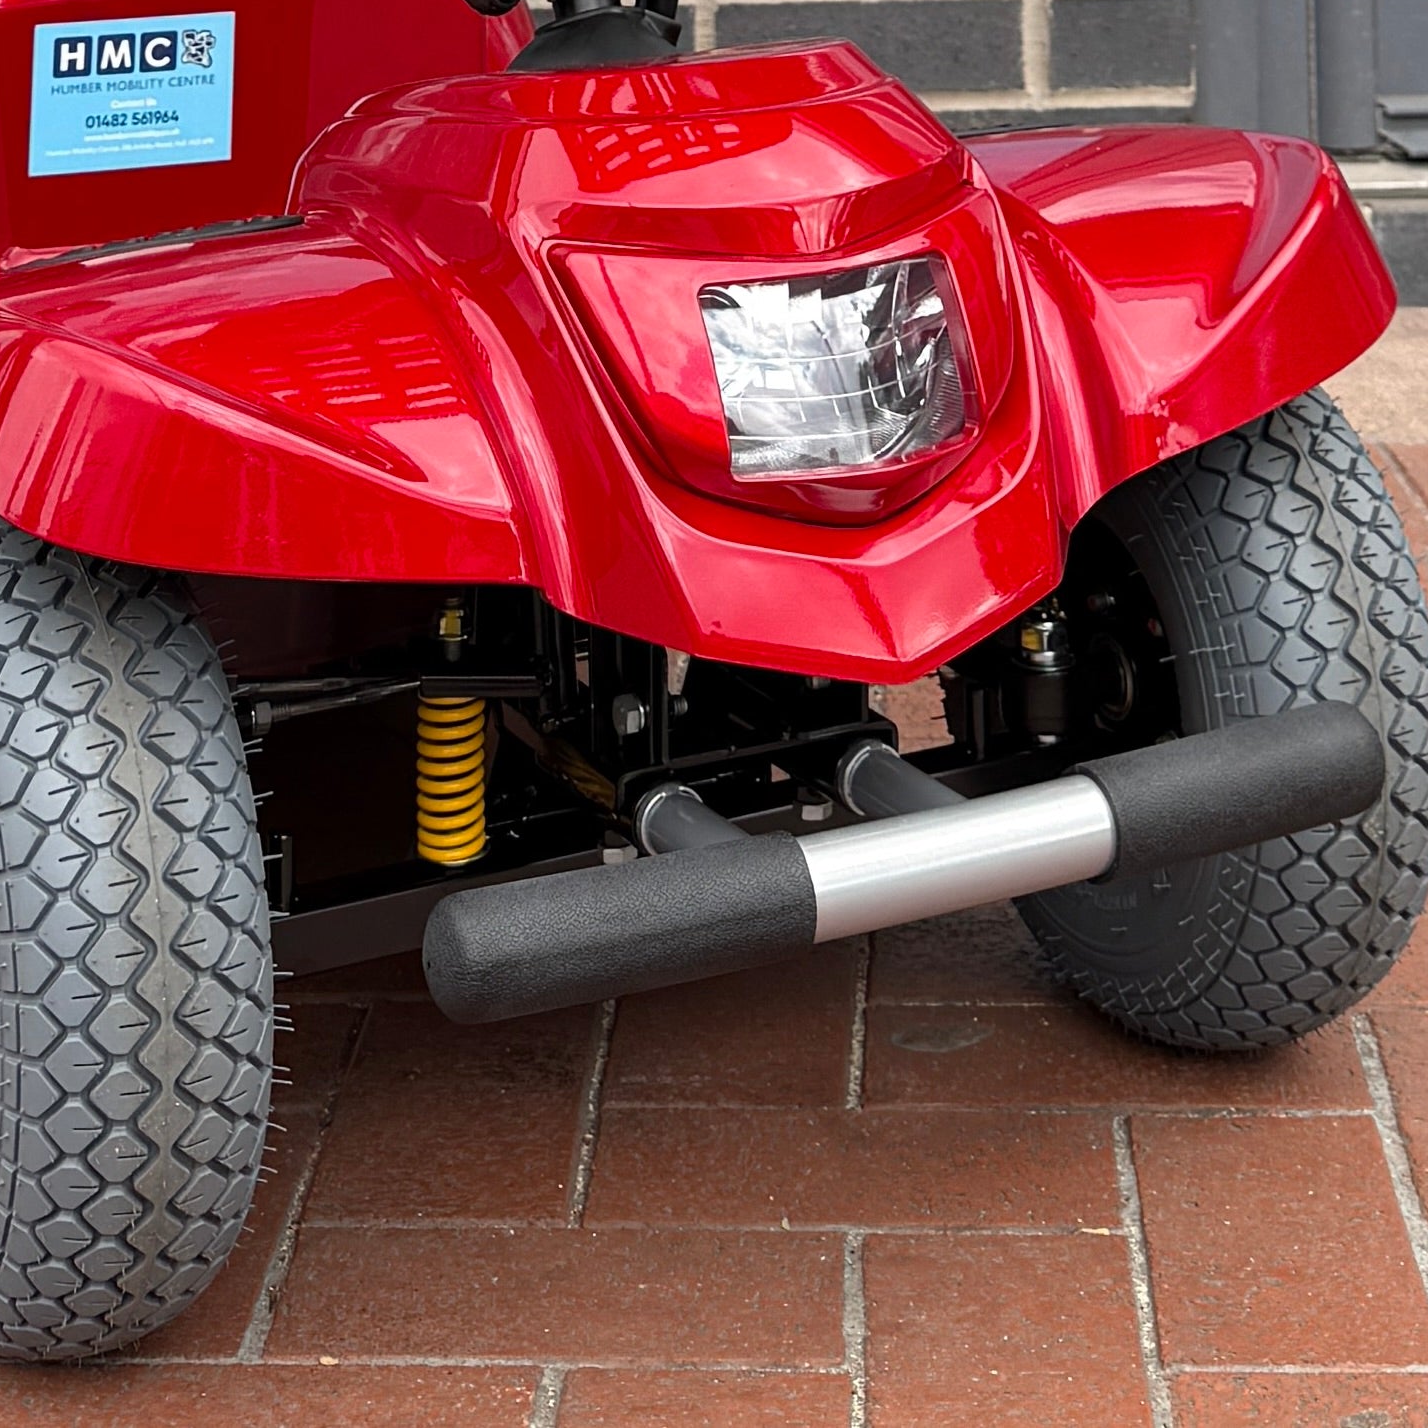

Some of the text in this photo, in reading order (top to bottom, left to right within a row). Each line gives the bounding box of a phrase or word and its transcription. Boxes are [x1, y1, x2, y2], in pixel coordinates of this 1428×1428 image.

[59, 36, 172, 73] HMC
[51, 74, 216, 96] HUMBER MOBILITY CENTRE
[85, 109, 180, 130] 01482 561964
